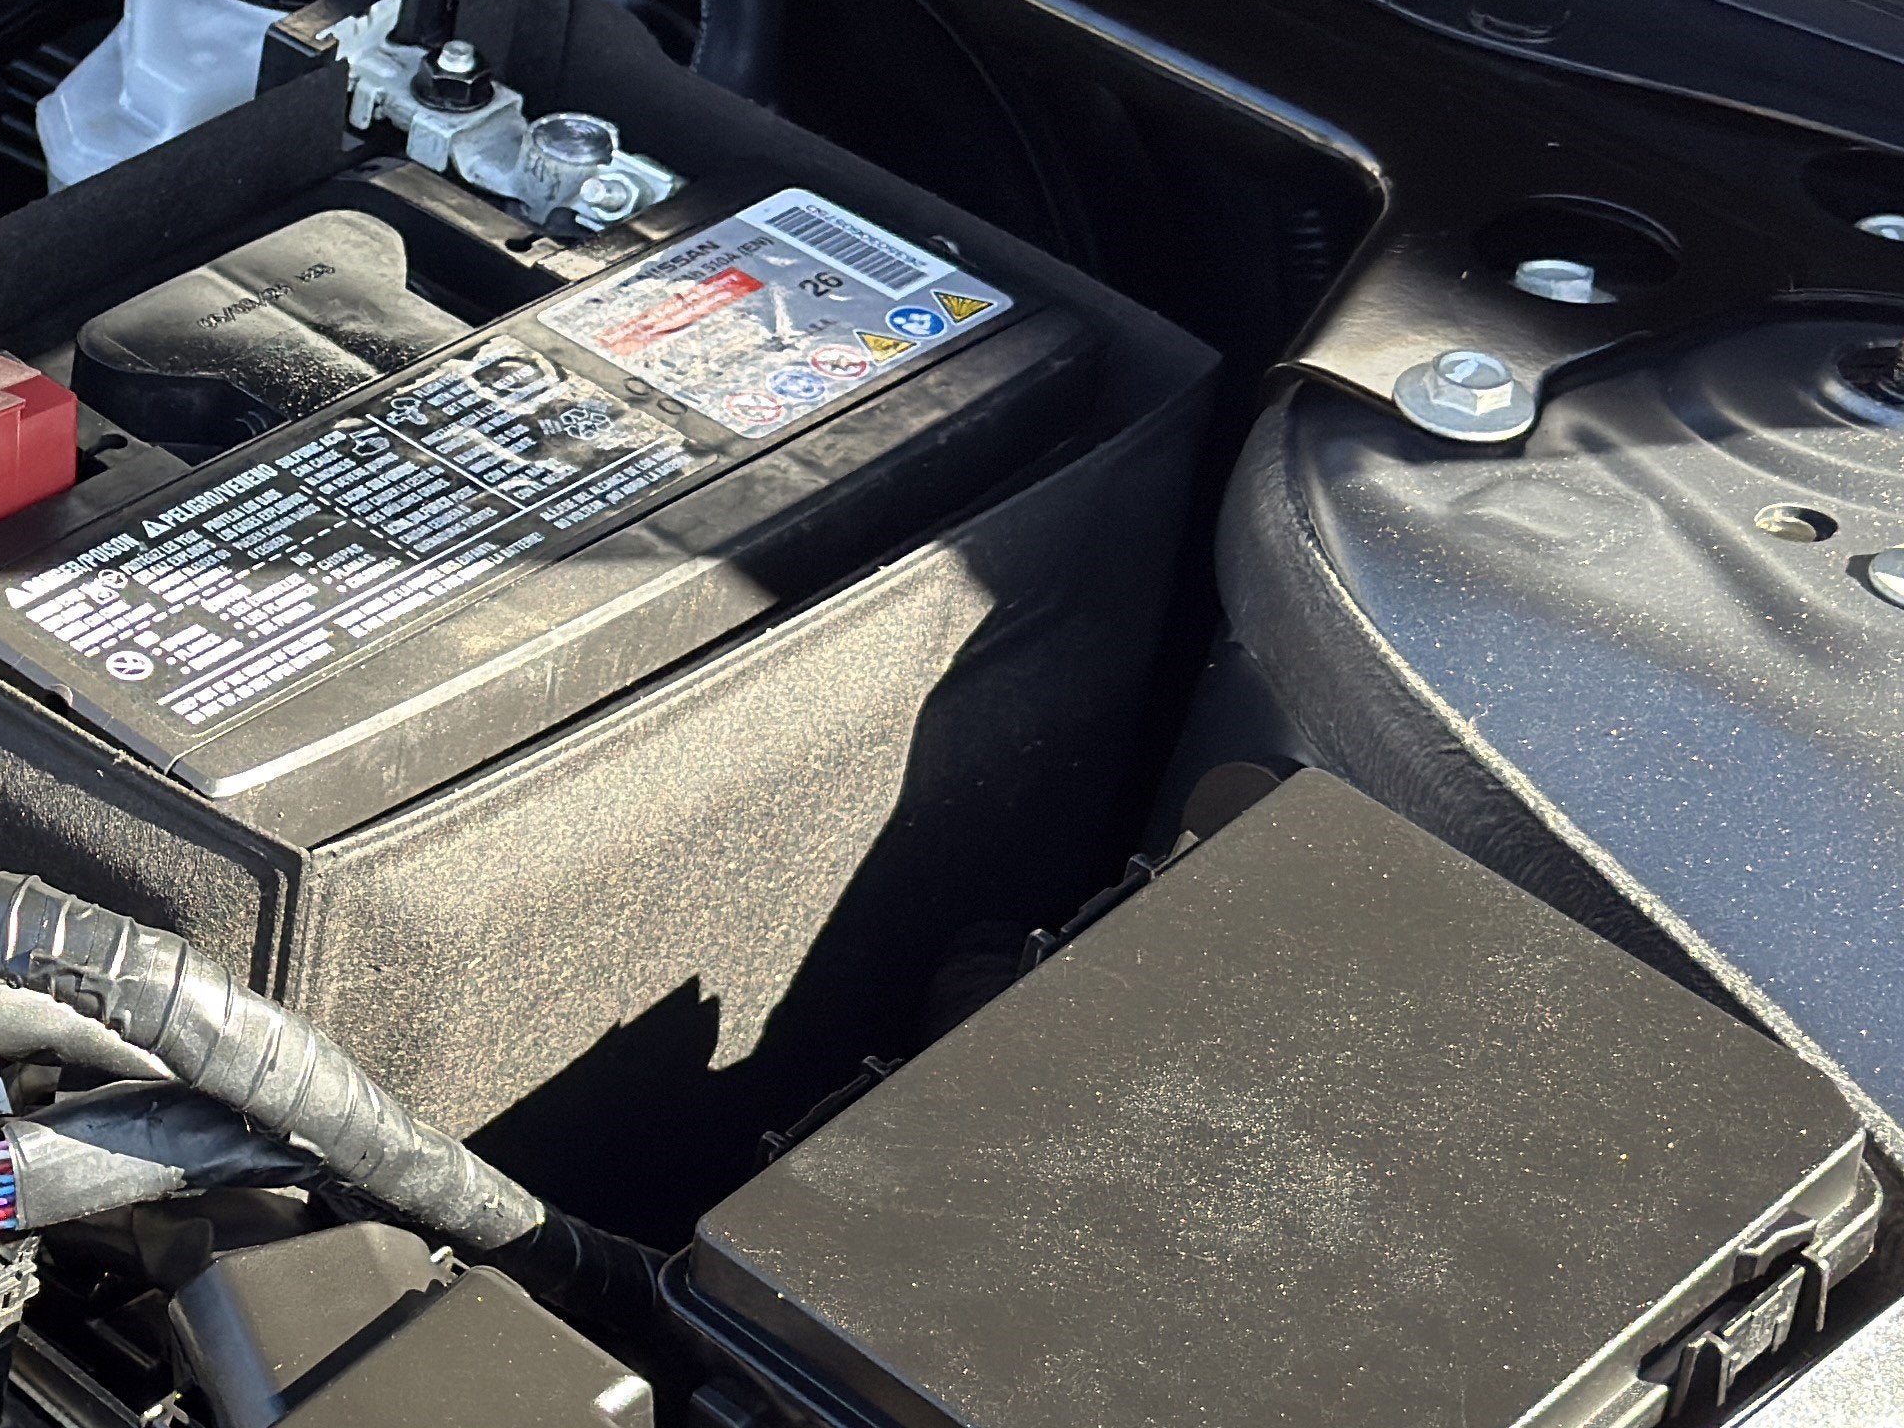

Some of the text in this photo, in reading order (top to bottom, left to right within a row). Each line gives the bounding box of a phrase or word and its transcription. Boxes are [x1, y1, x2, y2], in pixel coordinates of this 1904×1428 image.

[799, 272, 844, 297] 26
[161, 465, 275, 524] PELIGRO/VENENO
[290, 551, 313, 565] NO
[317, 543, 363, 570] CHISPAS
